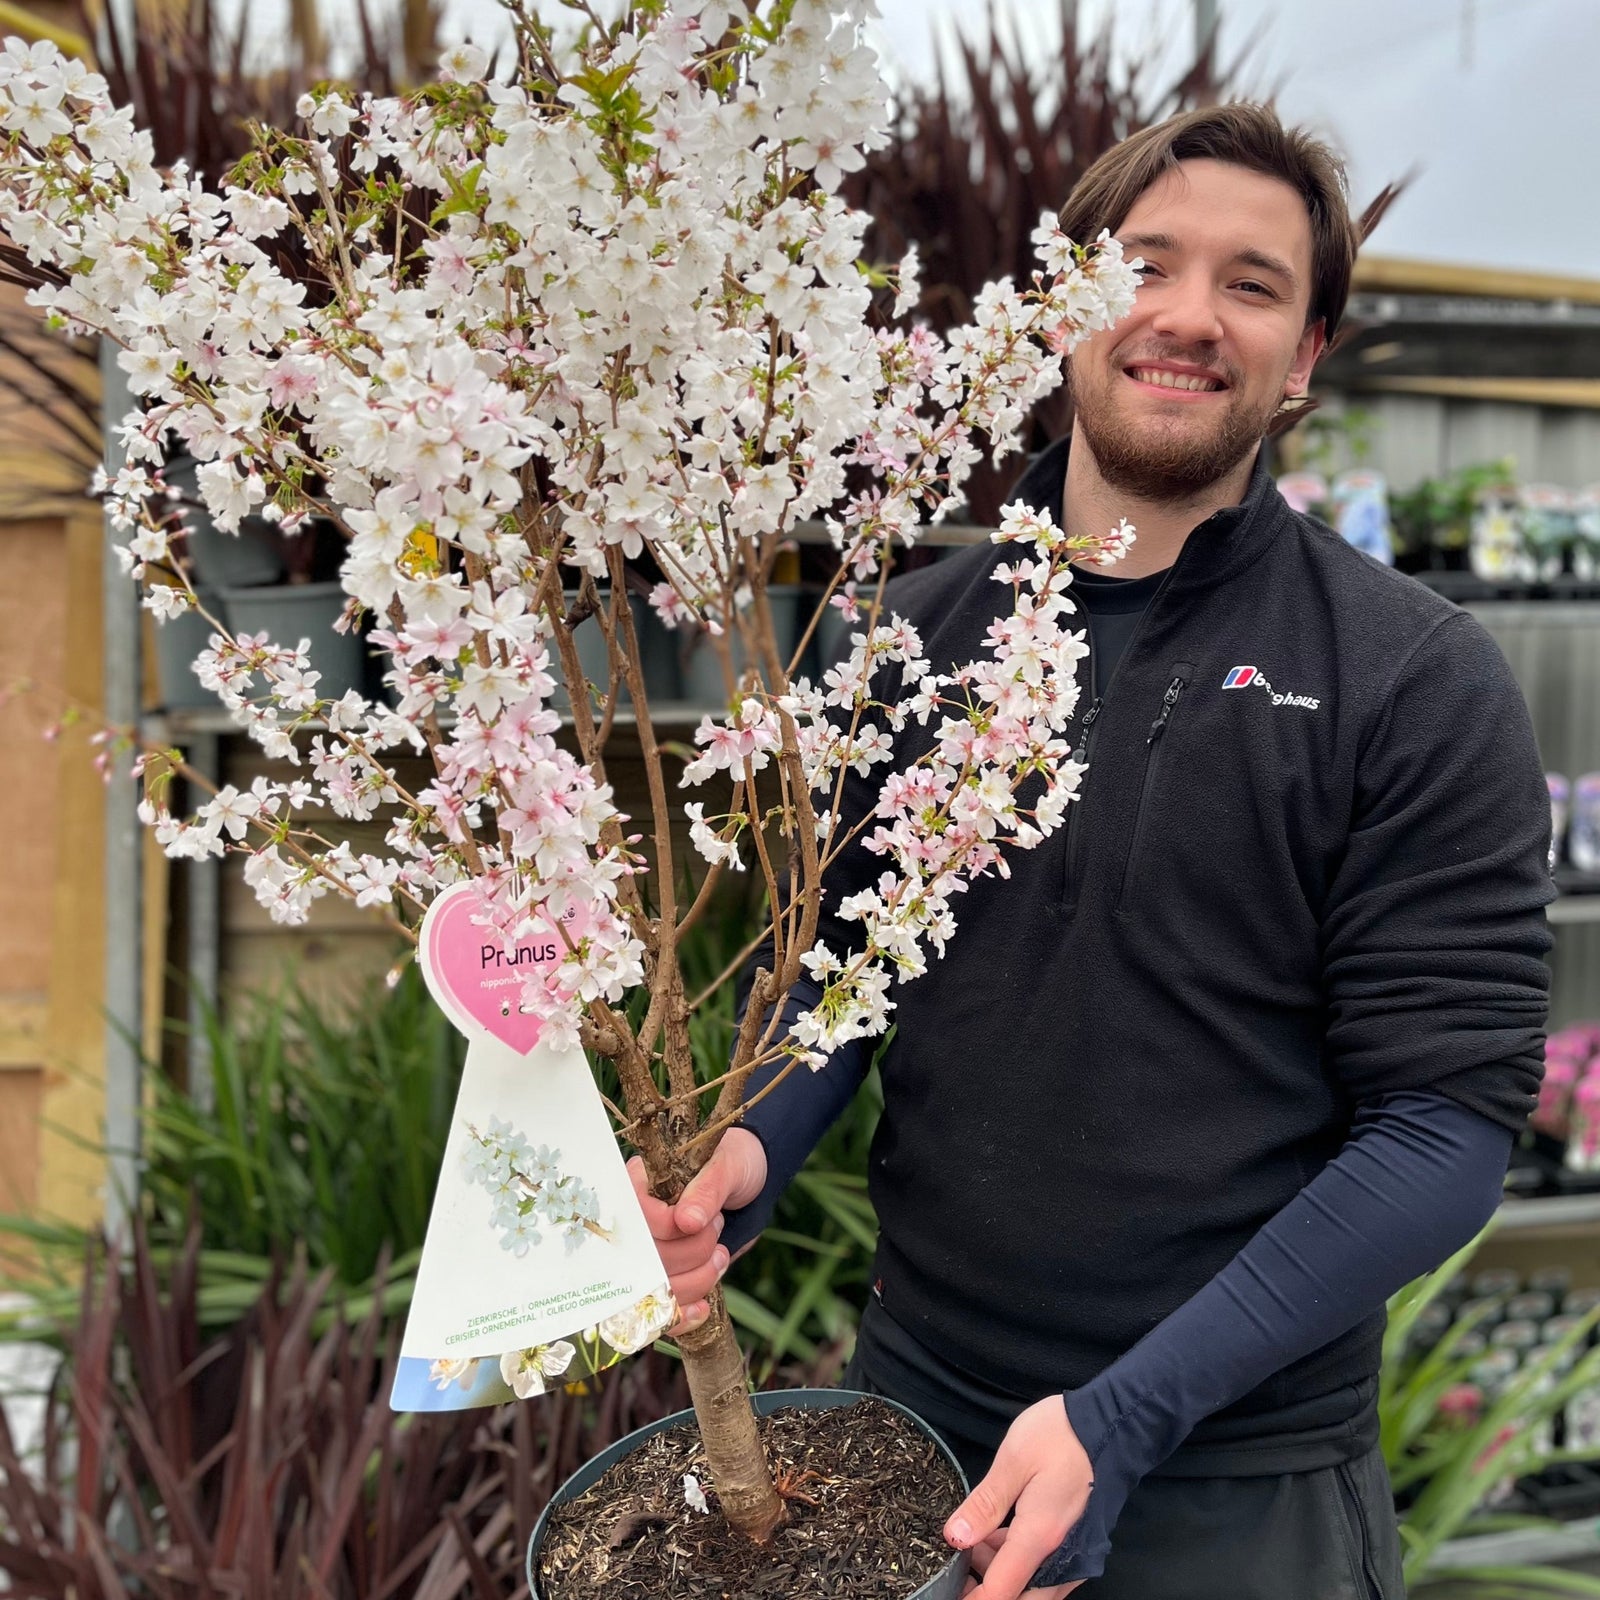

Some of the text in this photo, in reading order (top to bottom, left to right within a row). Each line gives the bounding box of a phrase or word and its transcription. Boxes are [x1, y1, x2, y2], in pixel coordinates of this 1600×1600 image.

[481, 944, 556, 969] Prunus
[480, 976, 521, 990] nipponic
[467, 1281, 611, 1328] ZIERKIRSCHE ORNAMENTAL CHERRY
[445, 1328, 480, 1345] CERISIER
[482, 1313, 536, 1335] ORNEMENTAL
